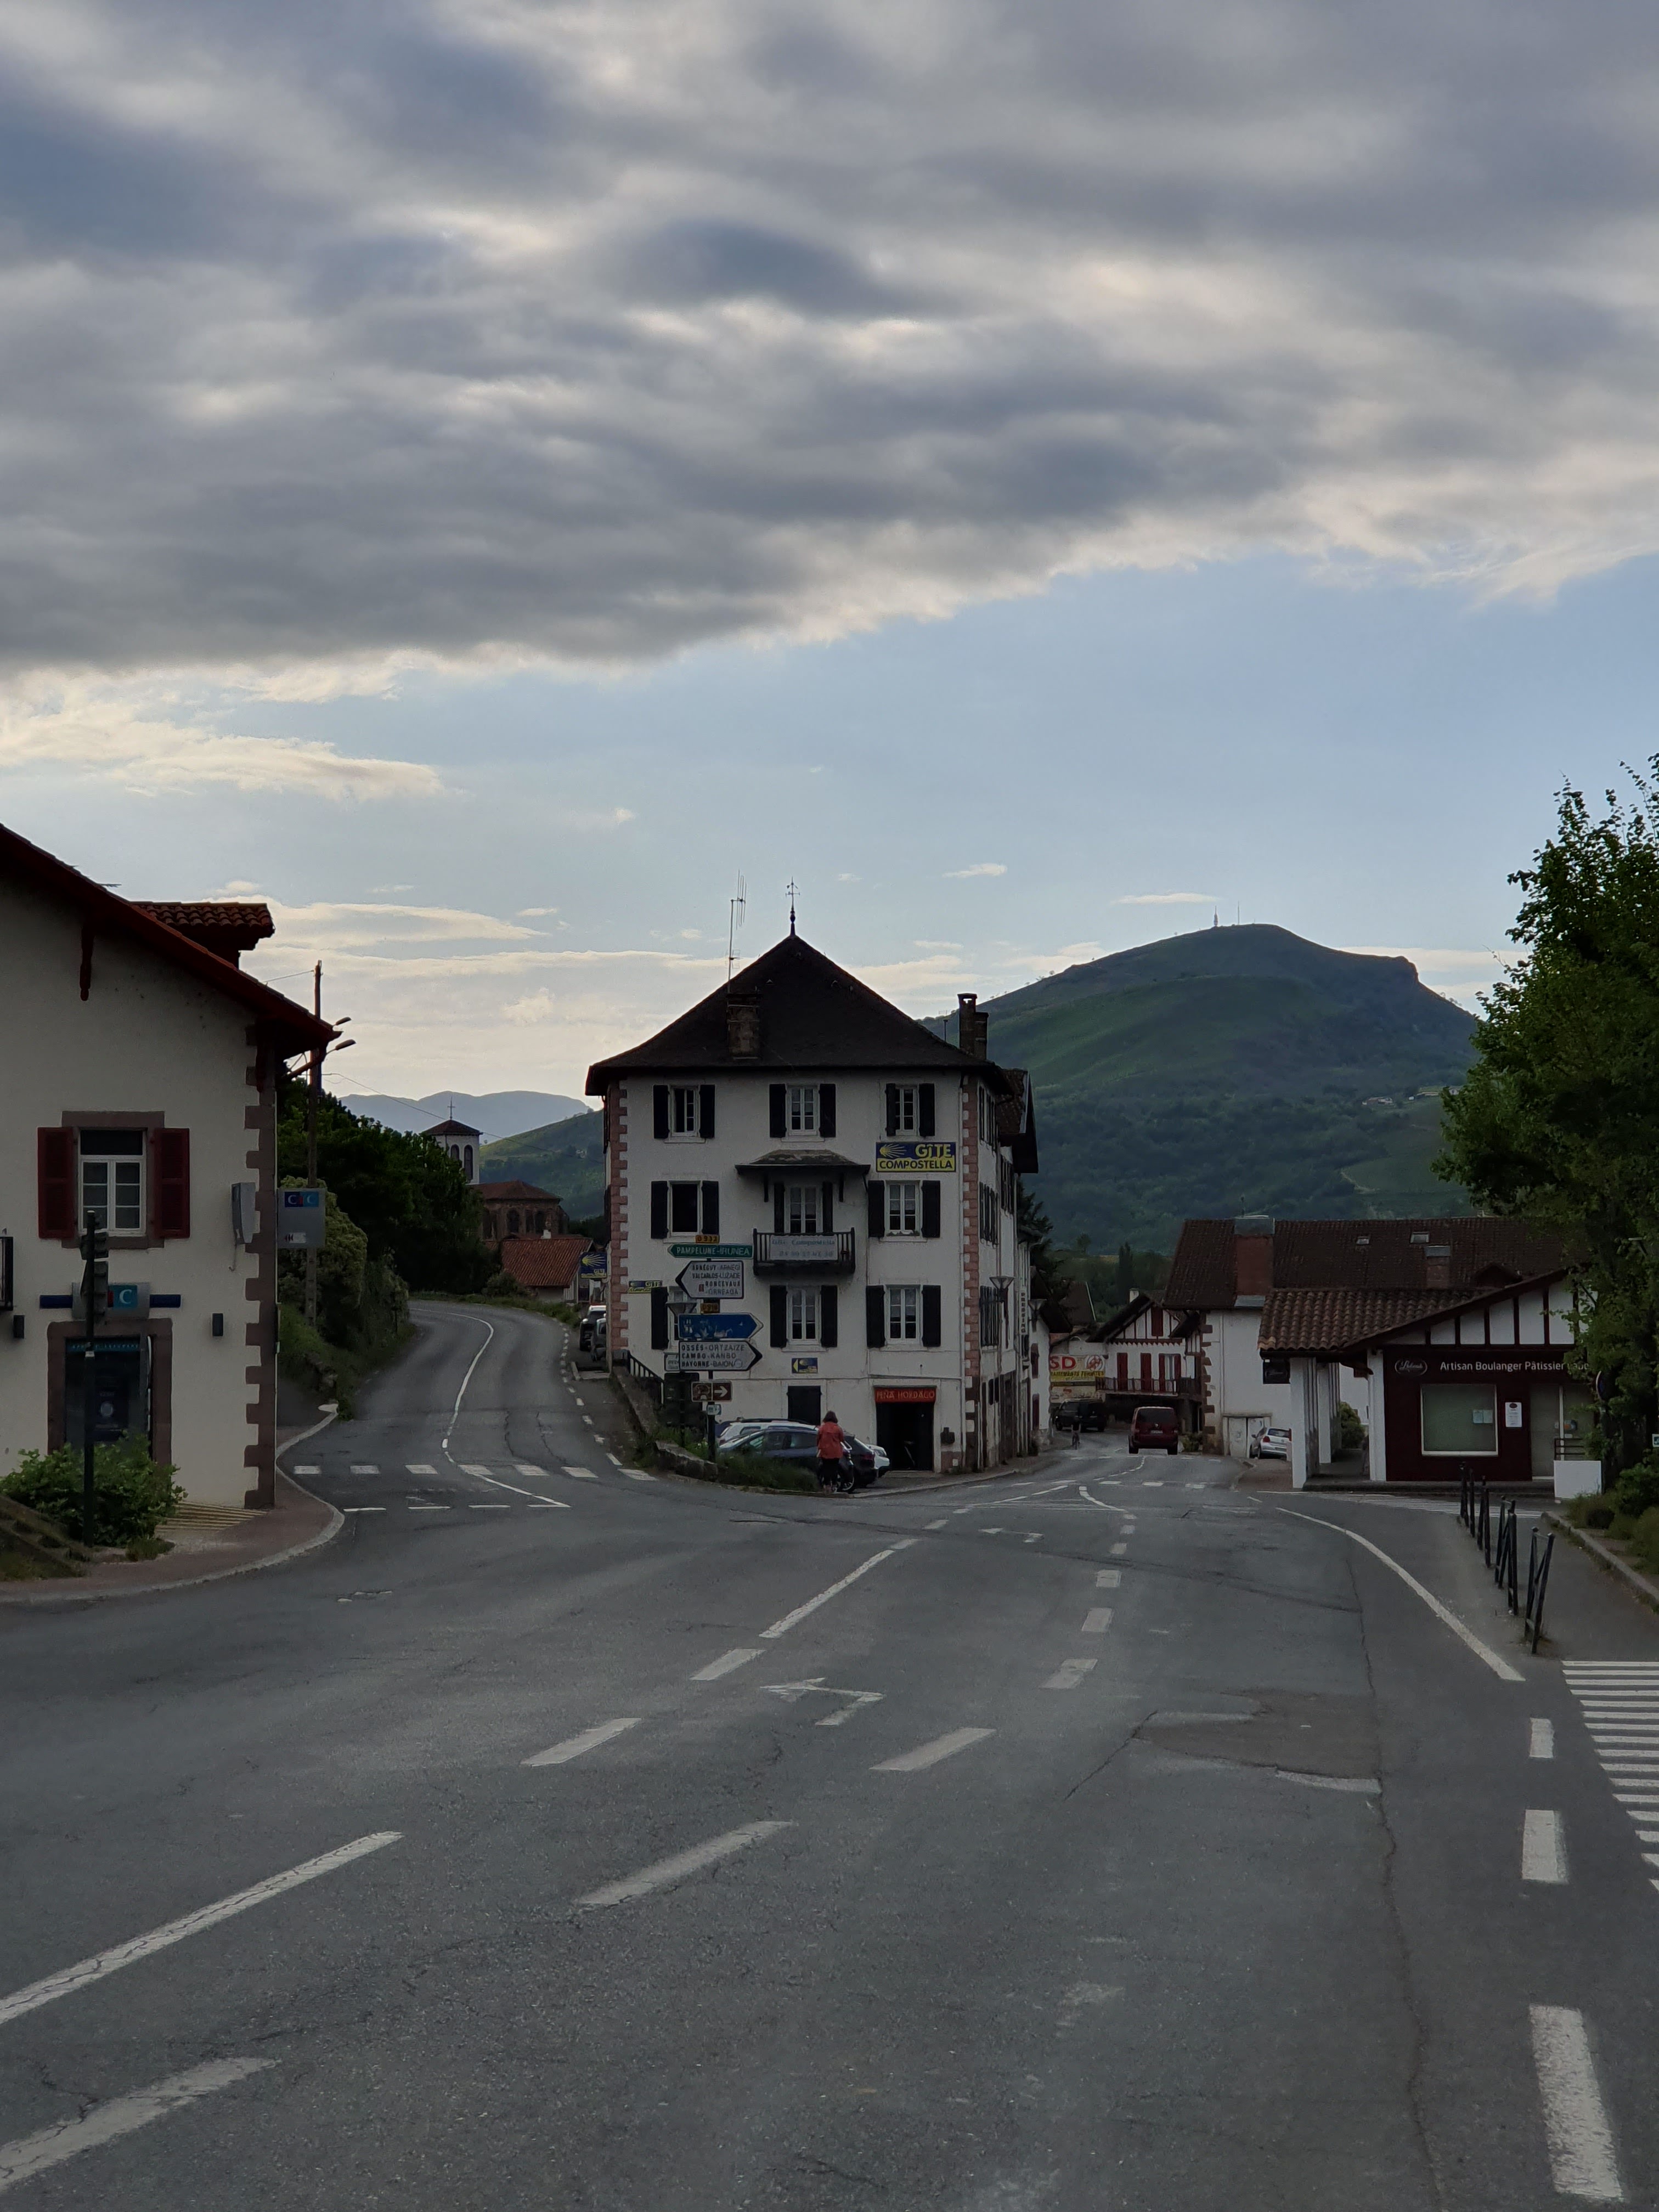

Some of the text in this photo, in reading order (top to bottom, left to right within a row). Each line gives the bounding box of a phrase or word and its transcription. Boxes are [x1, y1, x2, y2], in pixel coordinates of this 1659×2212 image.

[915, 1143, 951, 1158] GÎTE
[879, 1160, 953, 1169] COMPOSTELLA
[1440, 1362, 1473, 1370] Artisan
[1475, 1362, 1522, 1372] Boulanger
[1525, 1361, 1565, 1370] Pâtissier
